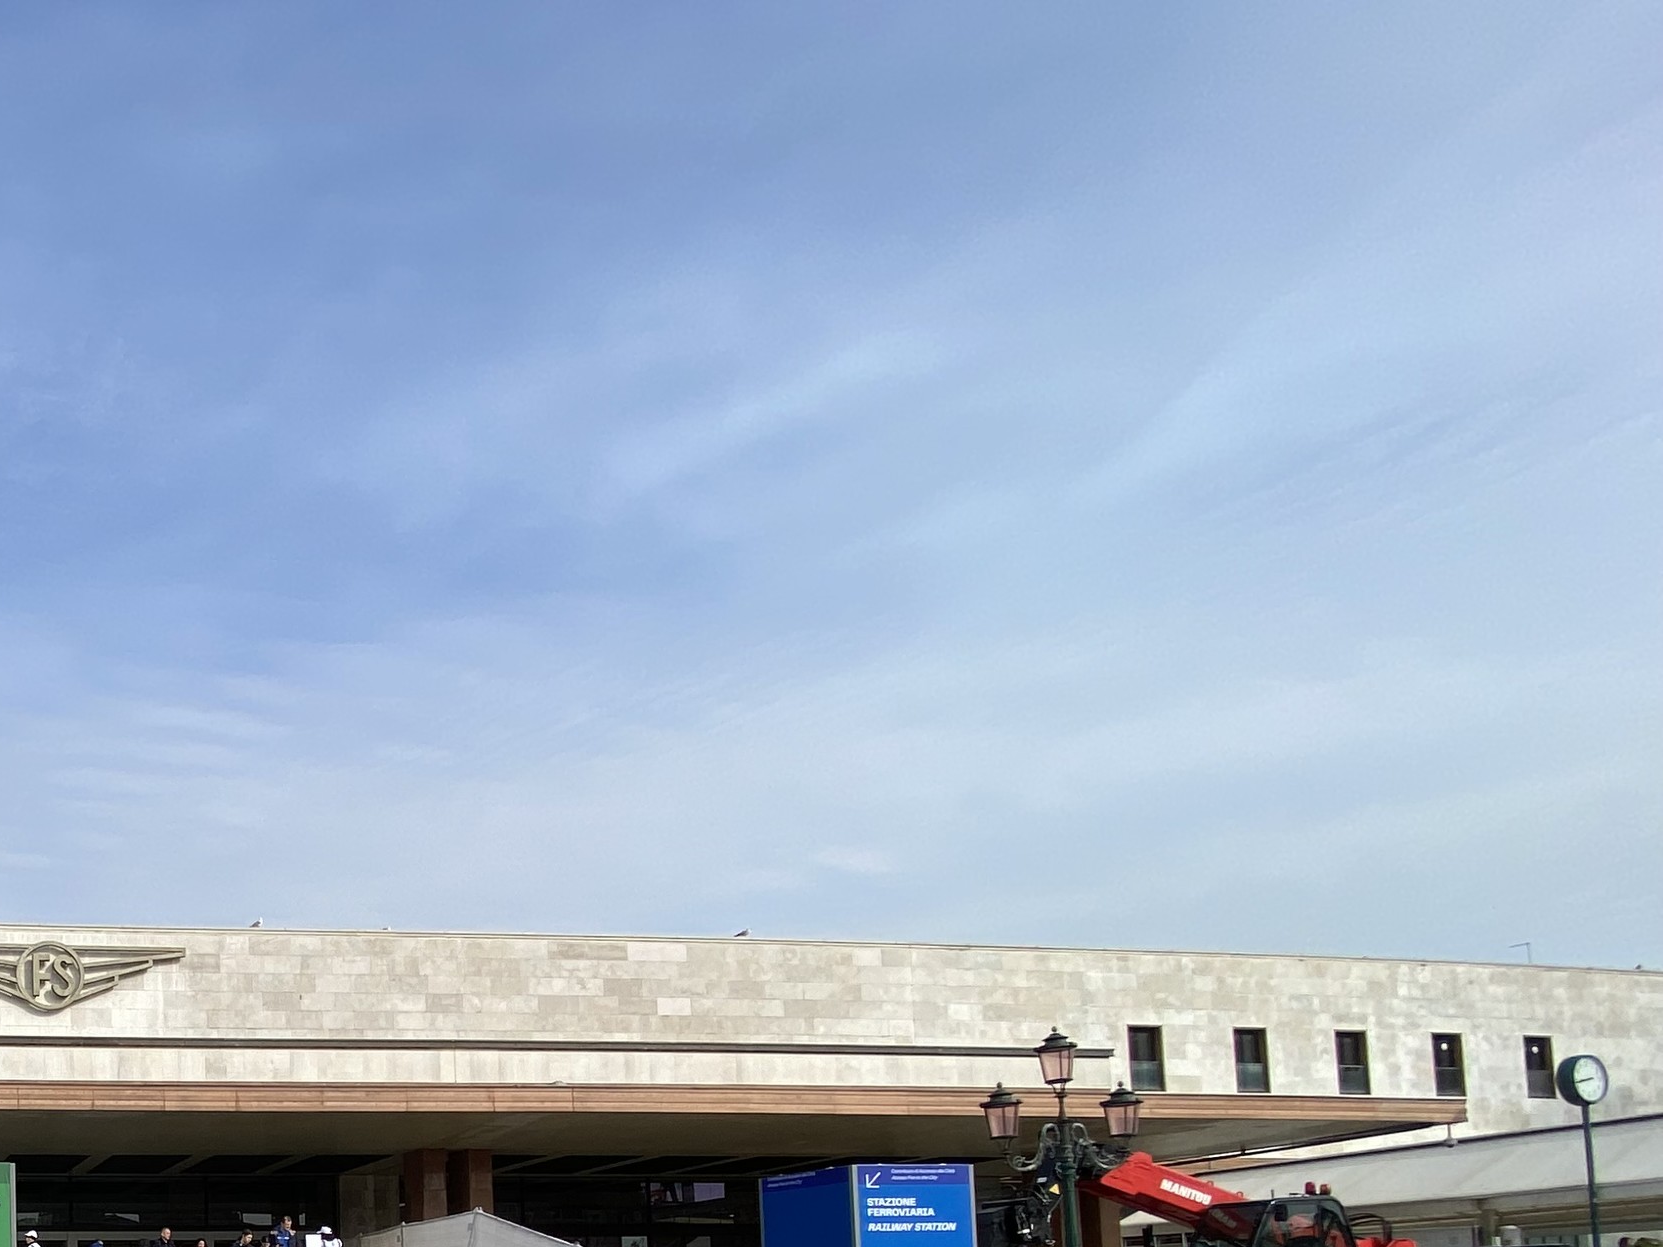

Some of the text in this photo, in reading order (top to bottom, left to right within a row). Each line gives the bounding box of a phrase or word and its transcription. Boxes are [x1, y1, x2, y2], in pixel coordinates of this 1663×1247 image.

[31, 953, 74, 997] FS
[1160, 1178, 1212, 1206] MANITOU
[866, 1197, 916, 1207] STAZIONE
[867, 1207, 935, 1217] FERROVIARIA
[868, 1222, 957, 1232] RAILWAY STATION
